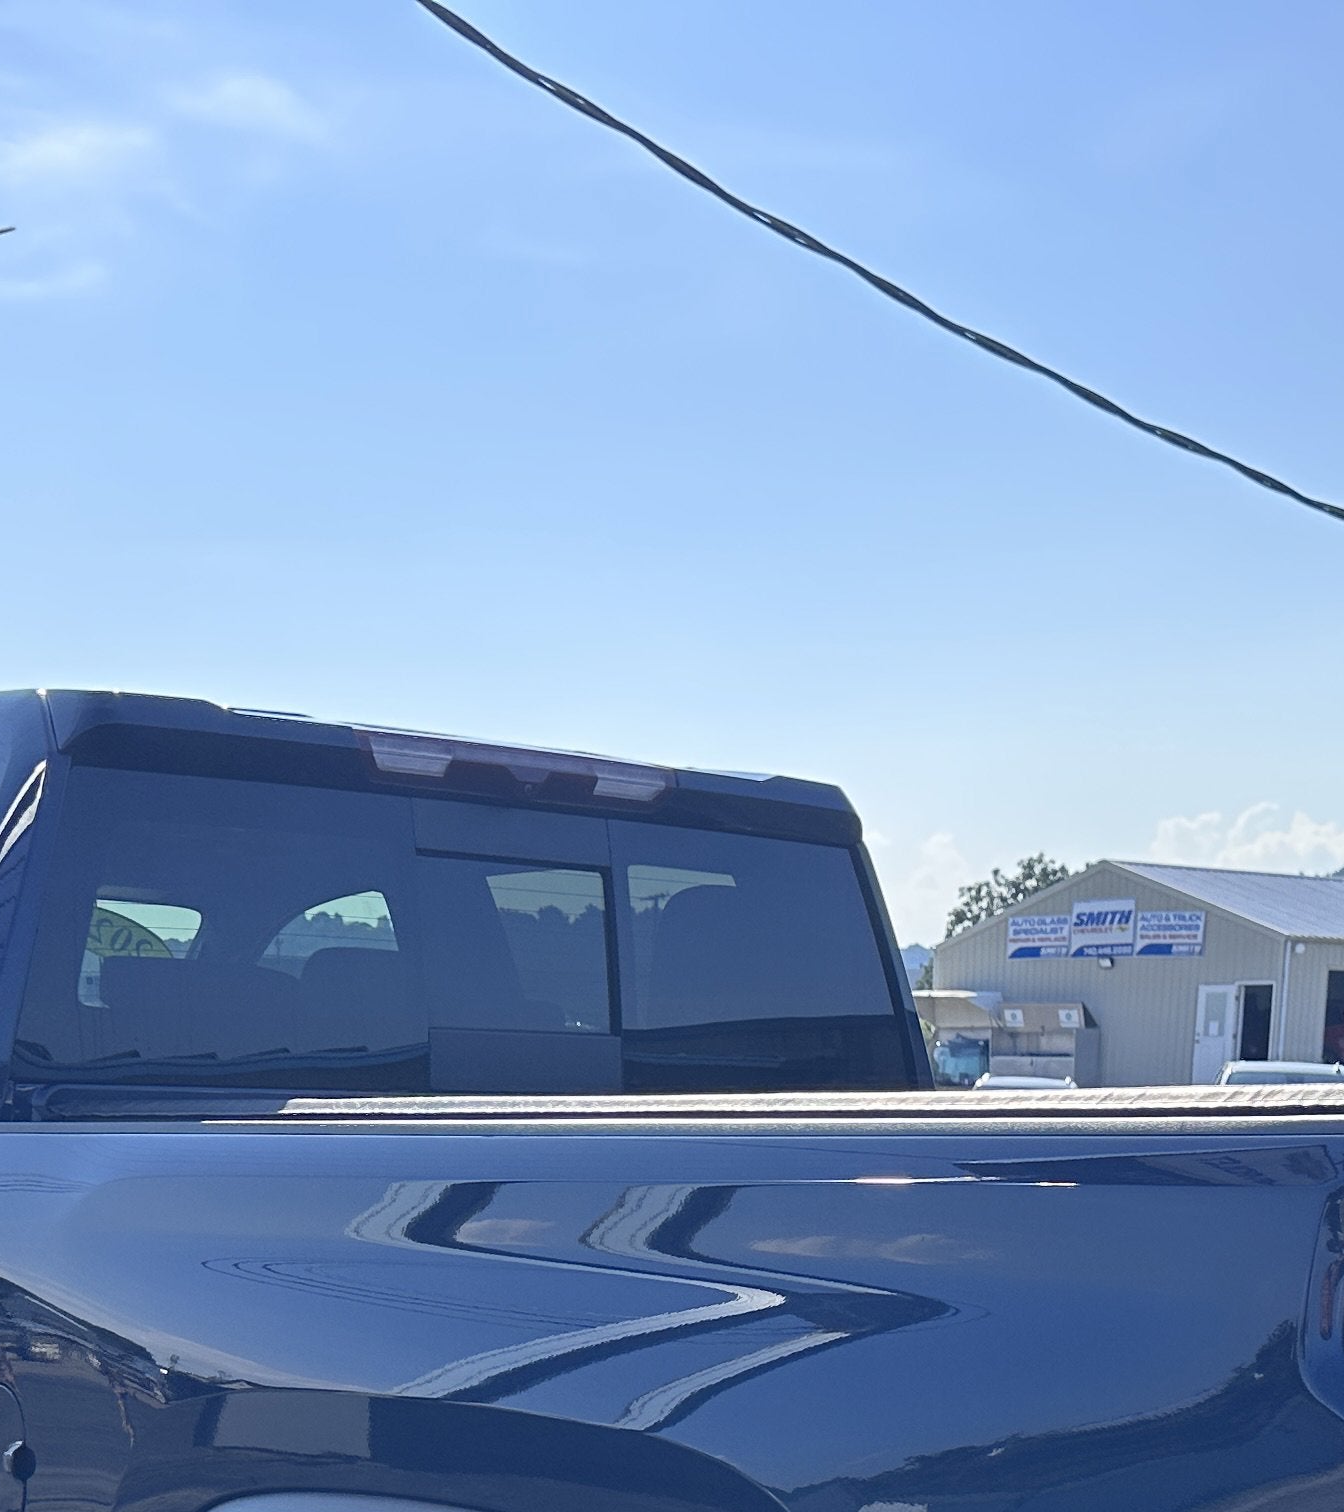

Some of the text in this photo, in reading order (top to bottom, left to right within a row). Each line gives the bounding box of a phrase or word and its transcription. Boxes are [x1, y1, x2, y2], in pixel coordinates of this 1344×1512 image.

[1010, 916, 1069, 927] AUTO GLASS
[1073, 910, 1133, 927] SMITH
[1141, 913, 1164, 922] AUTO
[1172, 912, 1202, 922] TRUCK
[1012, 926, 1064, 937] SPECIALIST
[1073, 926, 1113, 935] CHEVROLET
[1140, 923, 1201, 932] ACCESSORIES
